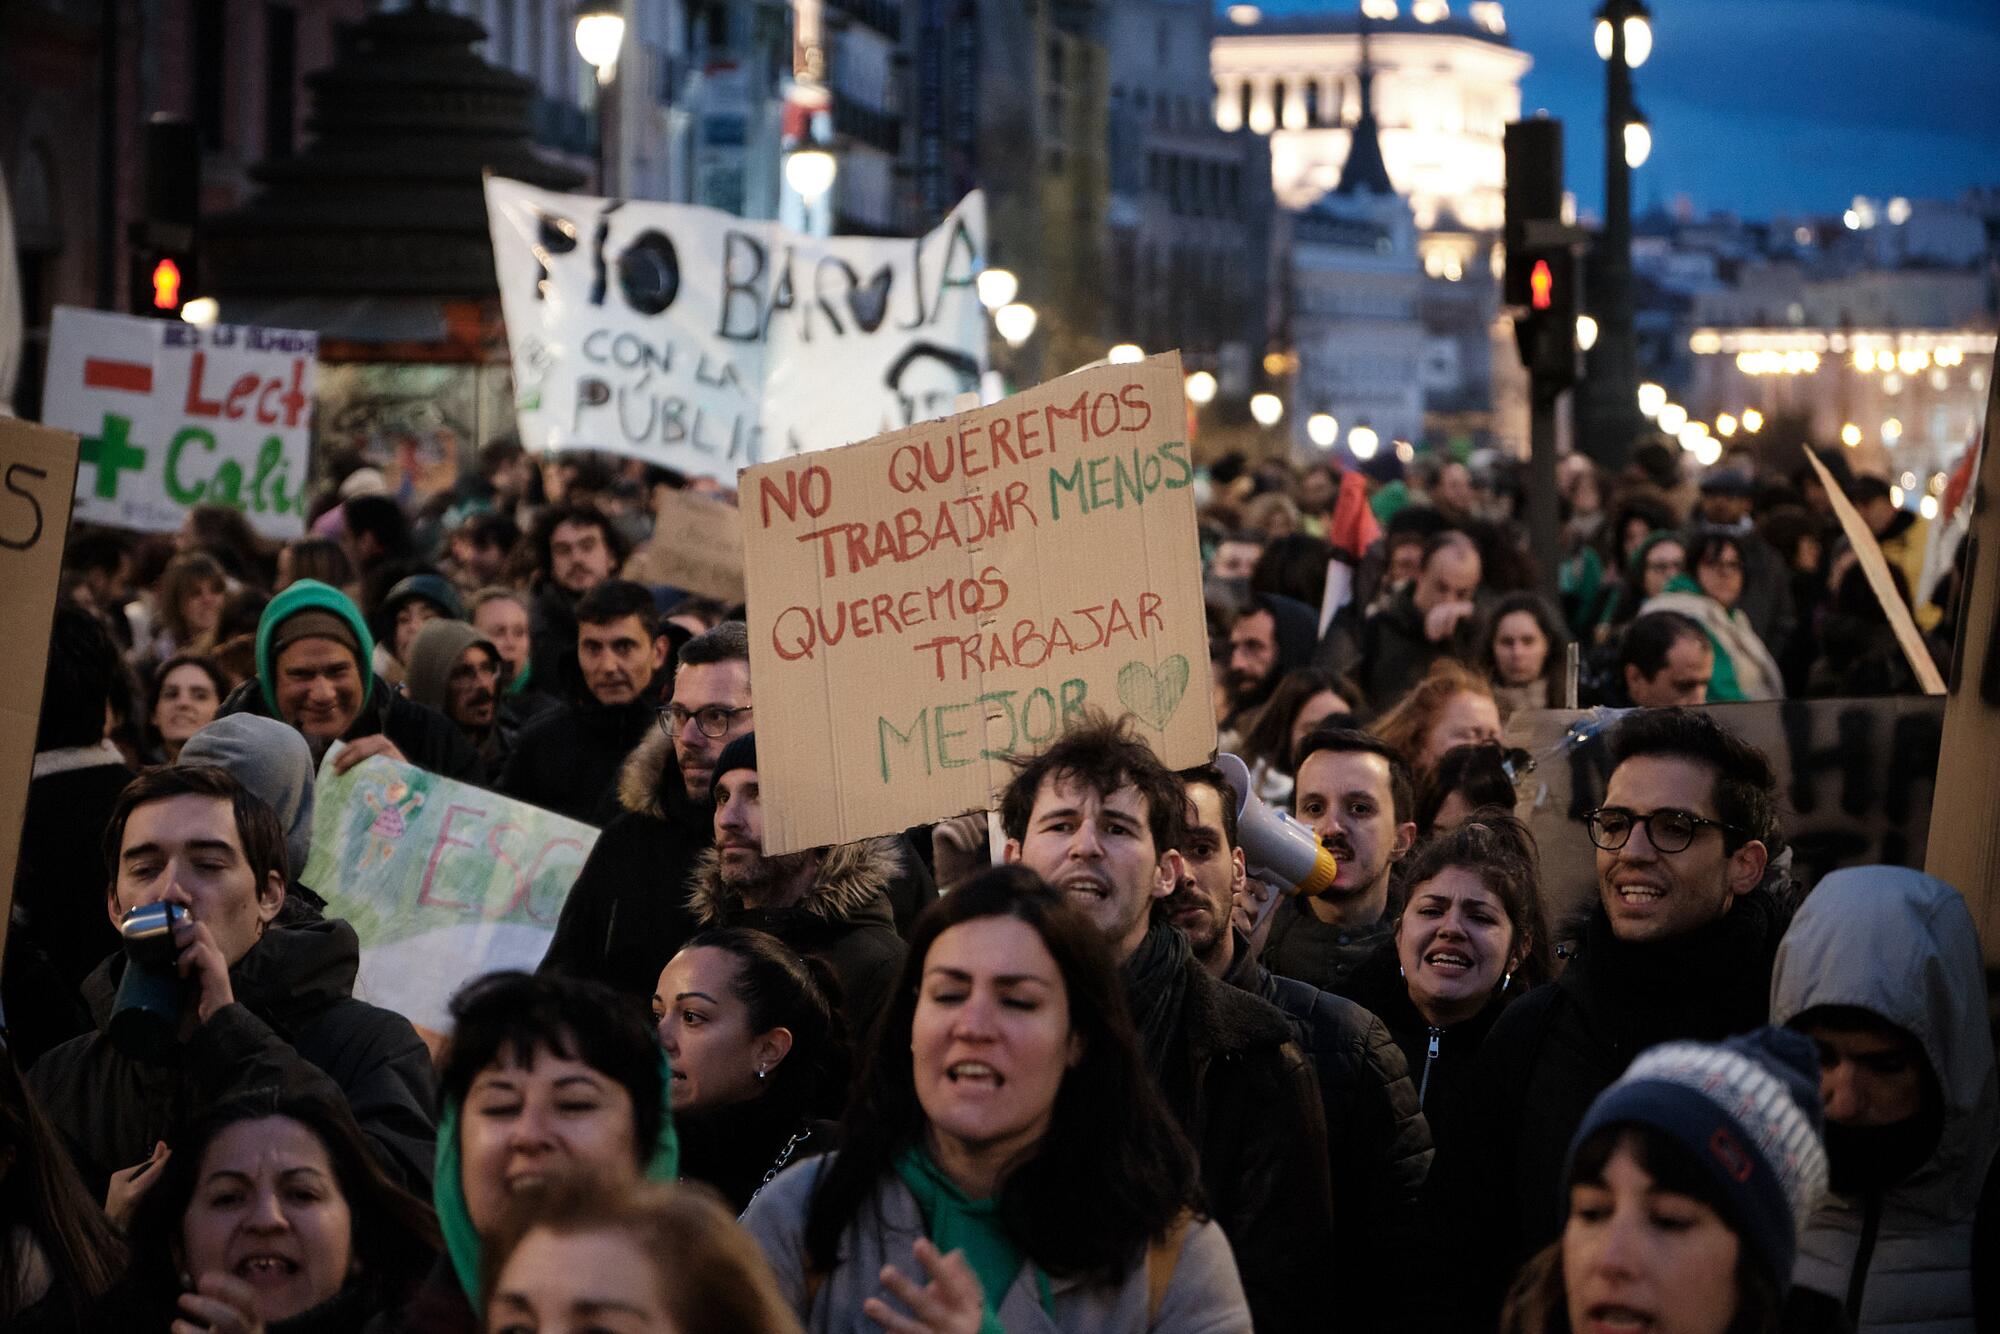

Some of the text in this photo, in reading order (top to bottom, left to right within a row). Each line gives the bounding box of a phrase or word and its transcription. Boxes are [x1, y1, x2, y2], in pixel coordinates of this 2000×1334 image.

[185, 350, 311, 428] Lect
[584, 329, 673, 374] CON
[164, 426, 306, 518] Cali
[759, 383, 1152, 528] NO QUEREMOS
[796, 481, 1038, 578] TRABAJAR
[1048, 441, 1194, 520] MENOS
[771, 566, 1009, 661] QUEREMOS
[913, 592, 1164, 682] TRABAJAR
[877, 678, 1089, 784] MEJOR
